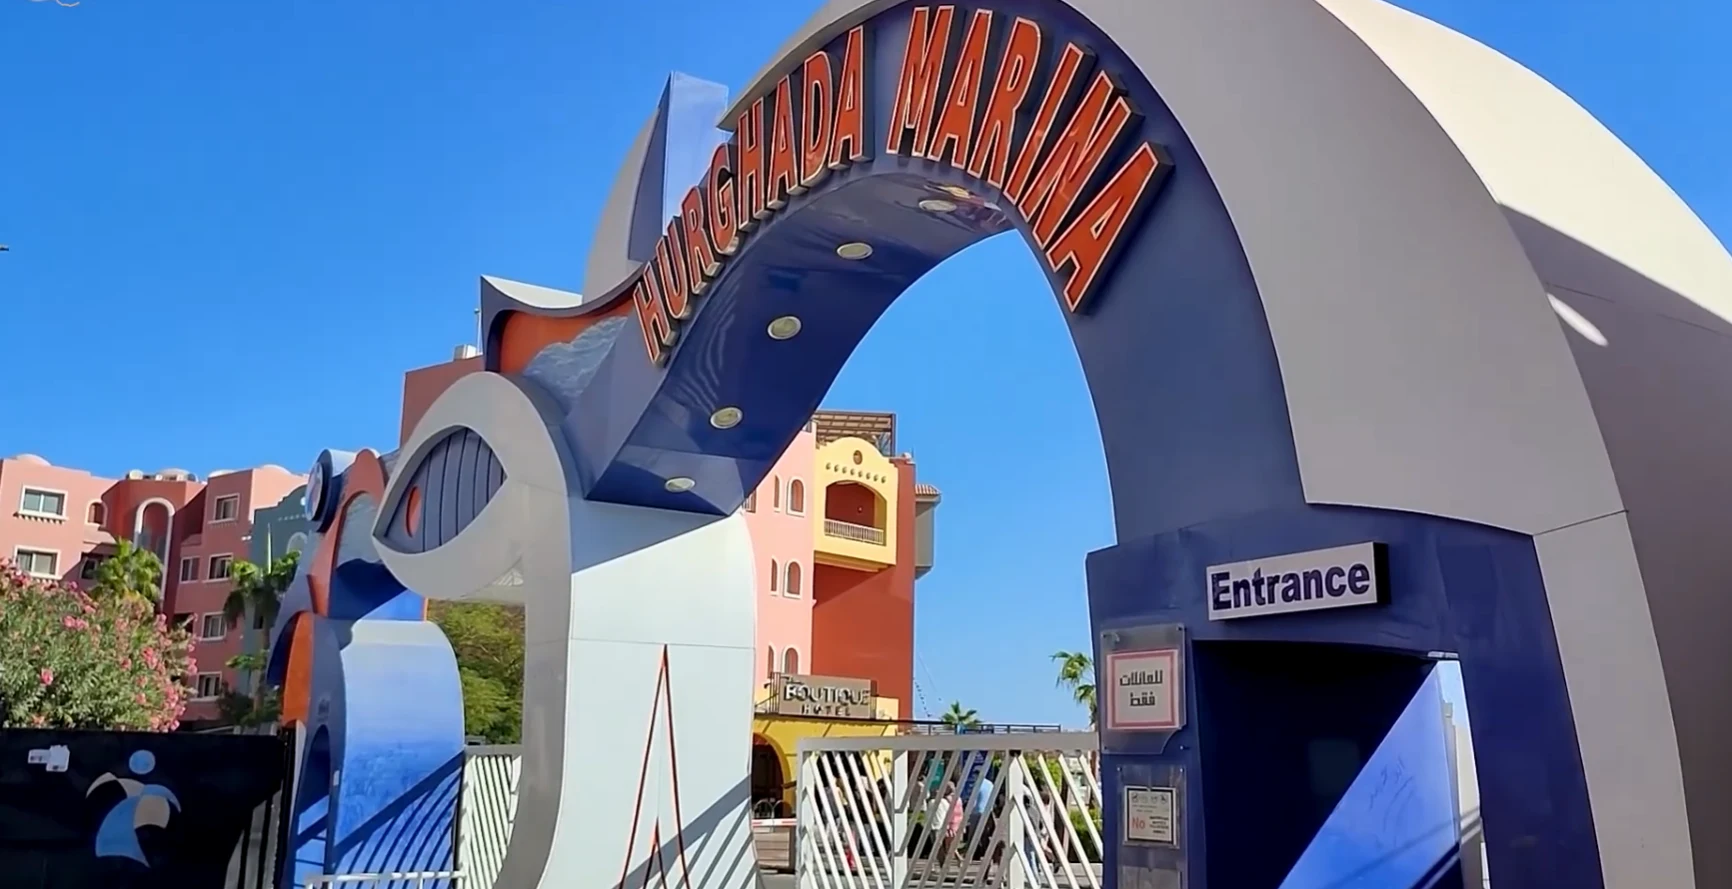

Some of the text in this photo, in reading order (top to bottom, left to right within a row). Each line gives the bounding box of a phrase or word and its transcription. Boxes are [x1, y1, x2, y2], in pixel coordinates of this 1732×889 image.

[632, 4, 1163, 367] HURGHADA MARINA
[1211, 563, 1370, 611] Entrance
[1119, 669, 1163, 686] للعائلات
[784, 684, 870, 706] BOUTIQUE
[1130, 691, 1156, 706] فقط
[801, 703, 851, 716] HOTEL
[1132, 816, 1145, 830] No
